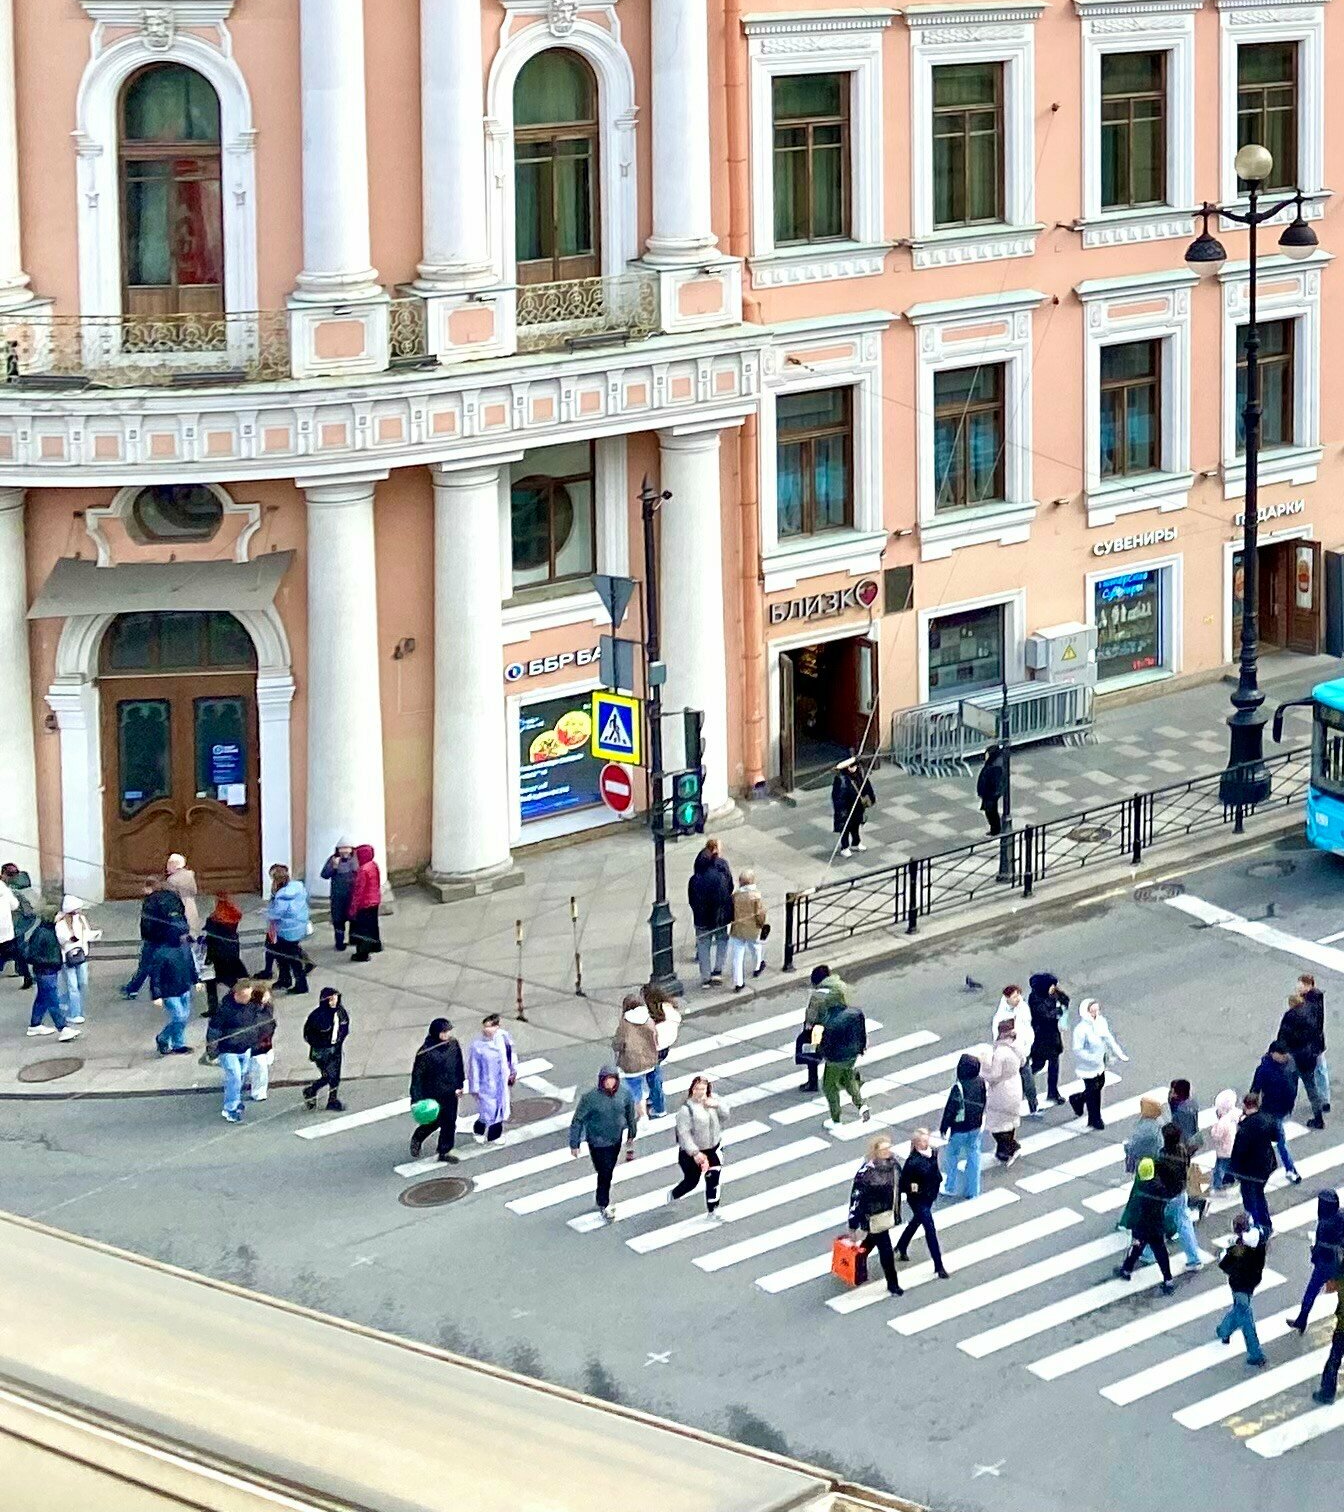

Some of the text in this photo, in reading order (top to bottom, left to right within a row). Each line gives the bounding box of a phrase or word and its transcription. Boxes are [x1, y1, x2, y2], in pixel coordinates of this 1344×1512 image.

[1235, 498, 1305, 526] ПДАРКИ
[1093, 527, 1178, 556] СУВЕНИРЫ
[528, 653, 575, 676] ББР
